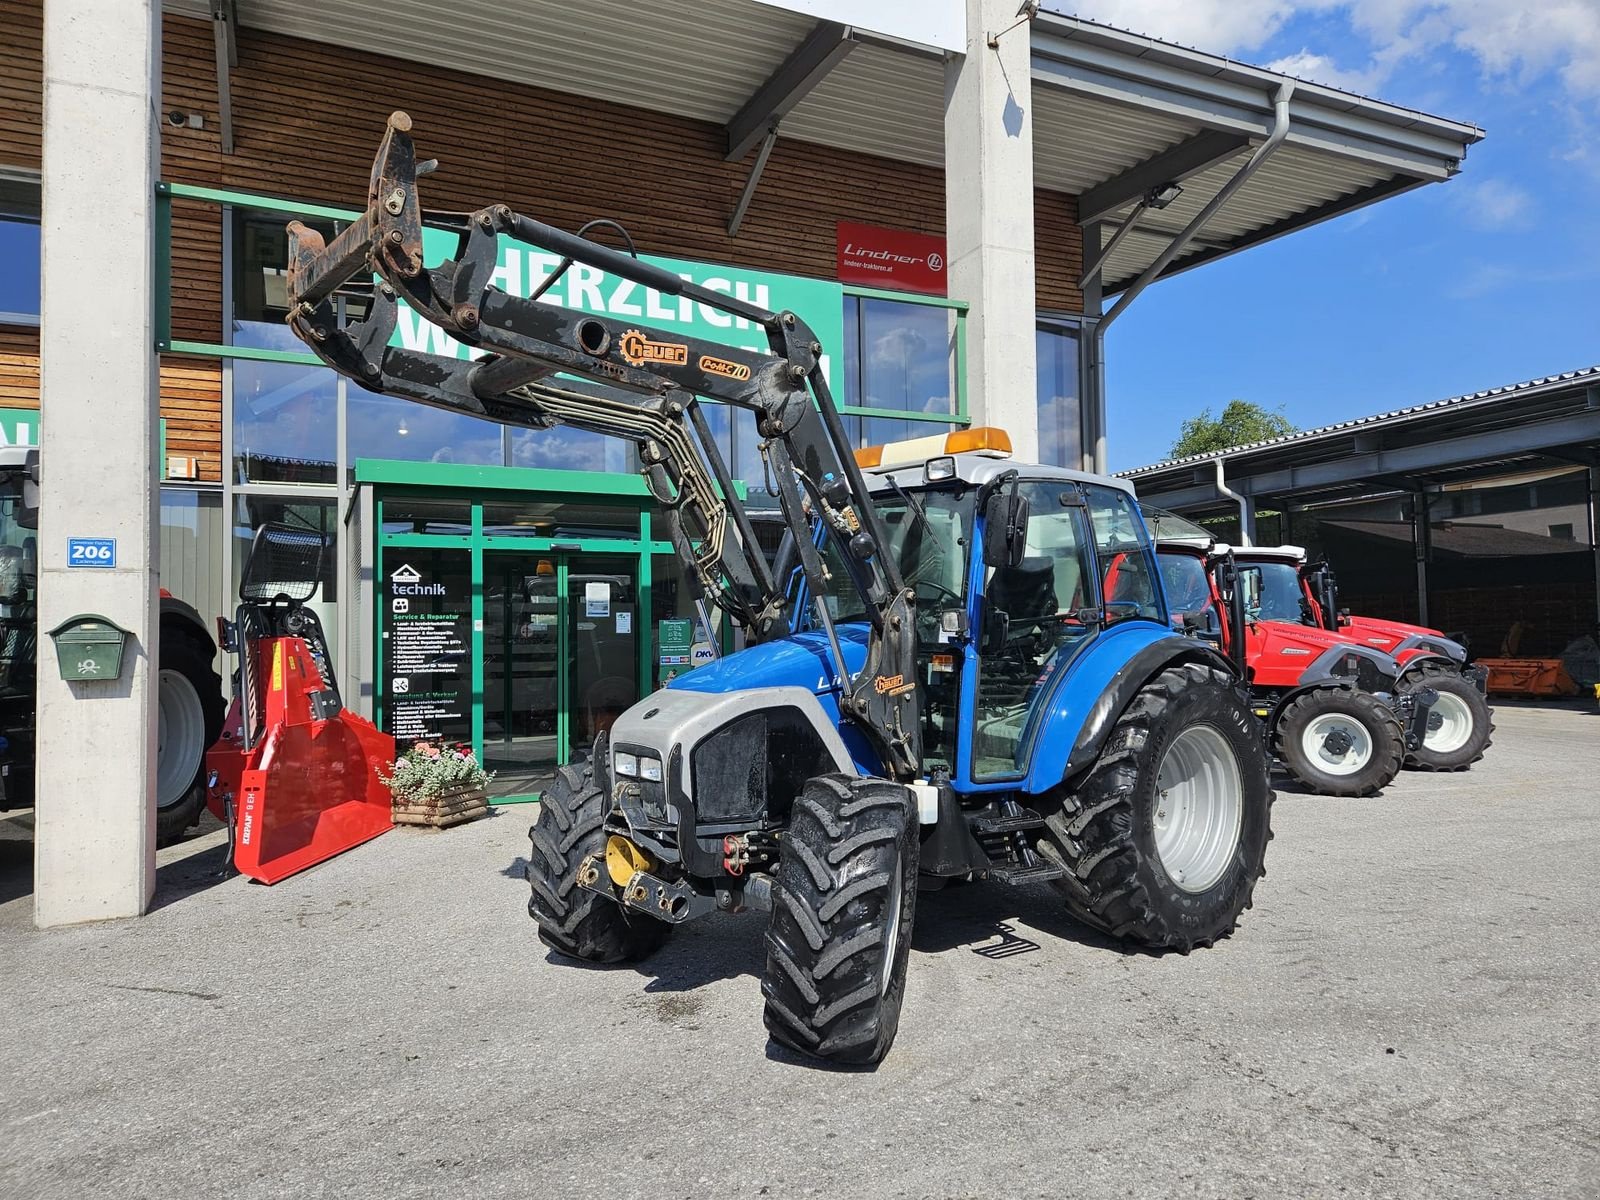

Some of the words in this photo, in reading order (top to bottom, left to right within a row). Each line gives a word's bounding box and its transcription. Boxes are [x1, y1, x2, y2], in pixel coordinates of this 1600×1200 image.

[844, 243, 924, 264] Lindner
[843, 259, 893, 272] lindner-traktoren.at
[487, 247, 769, 331] HERZLICH
[72, 545, 112, 559] 206
[392, 583, 446, 595] technik
[695, 650, 713, 658] DKV
[247, 793, 255, 804] EH
[242, 815, 253, 845] KRPAN
